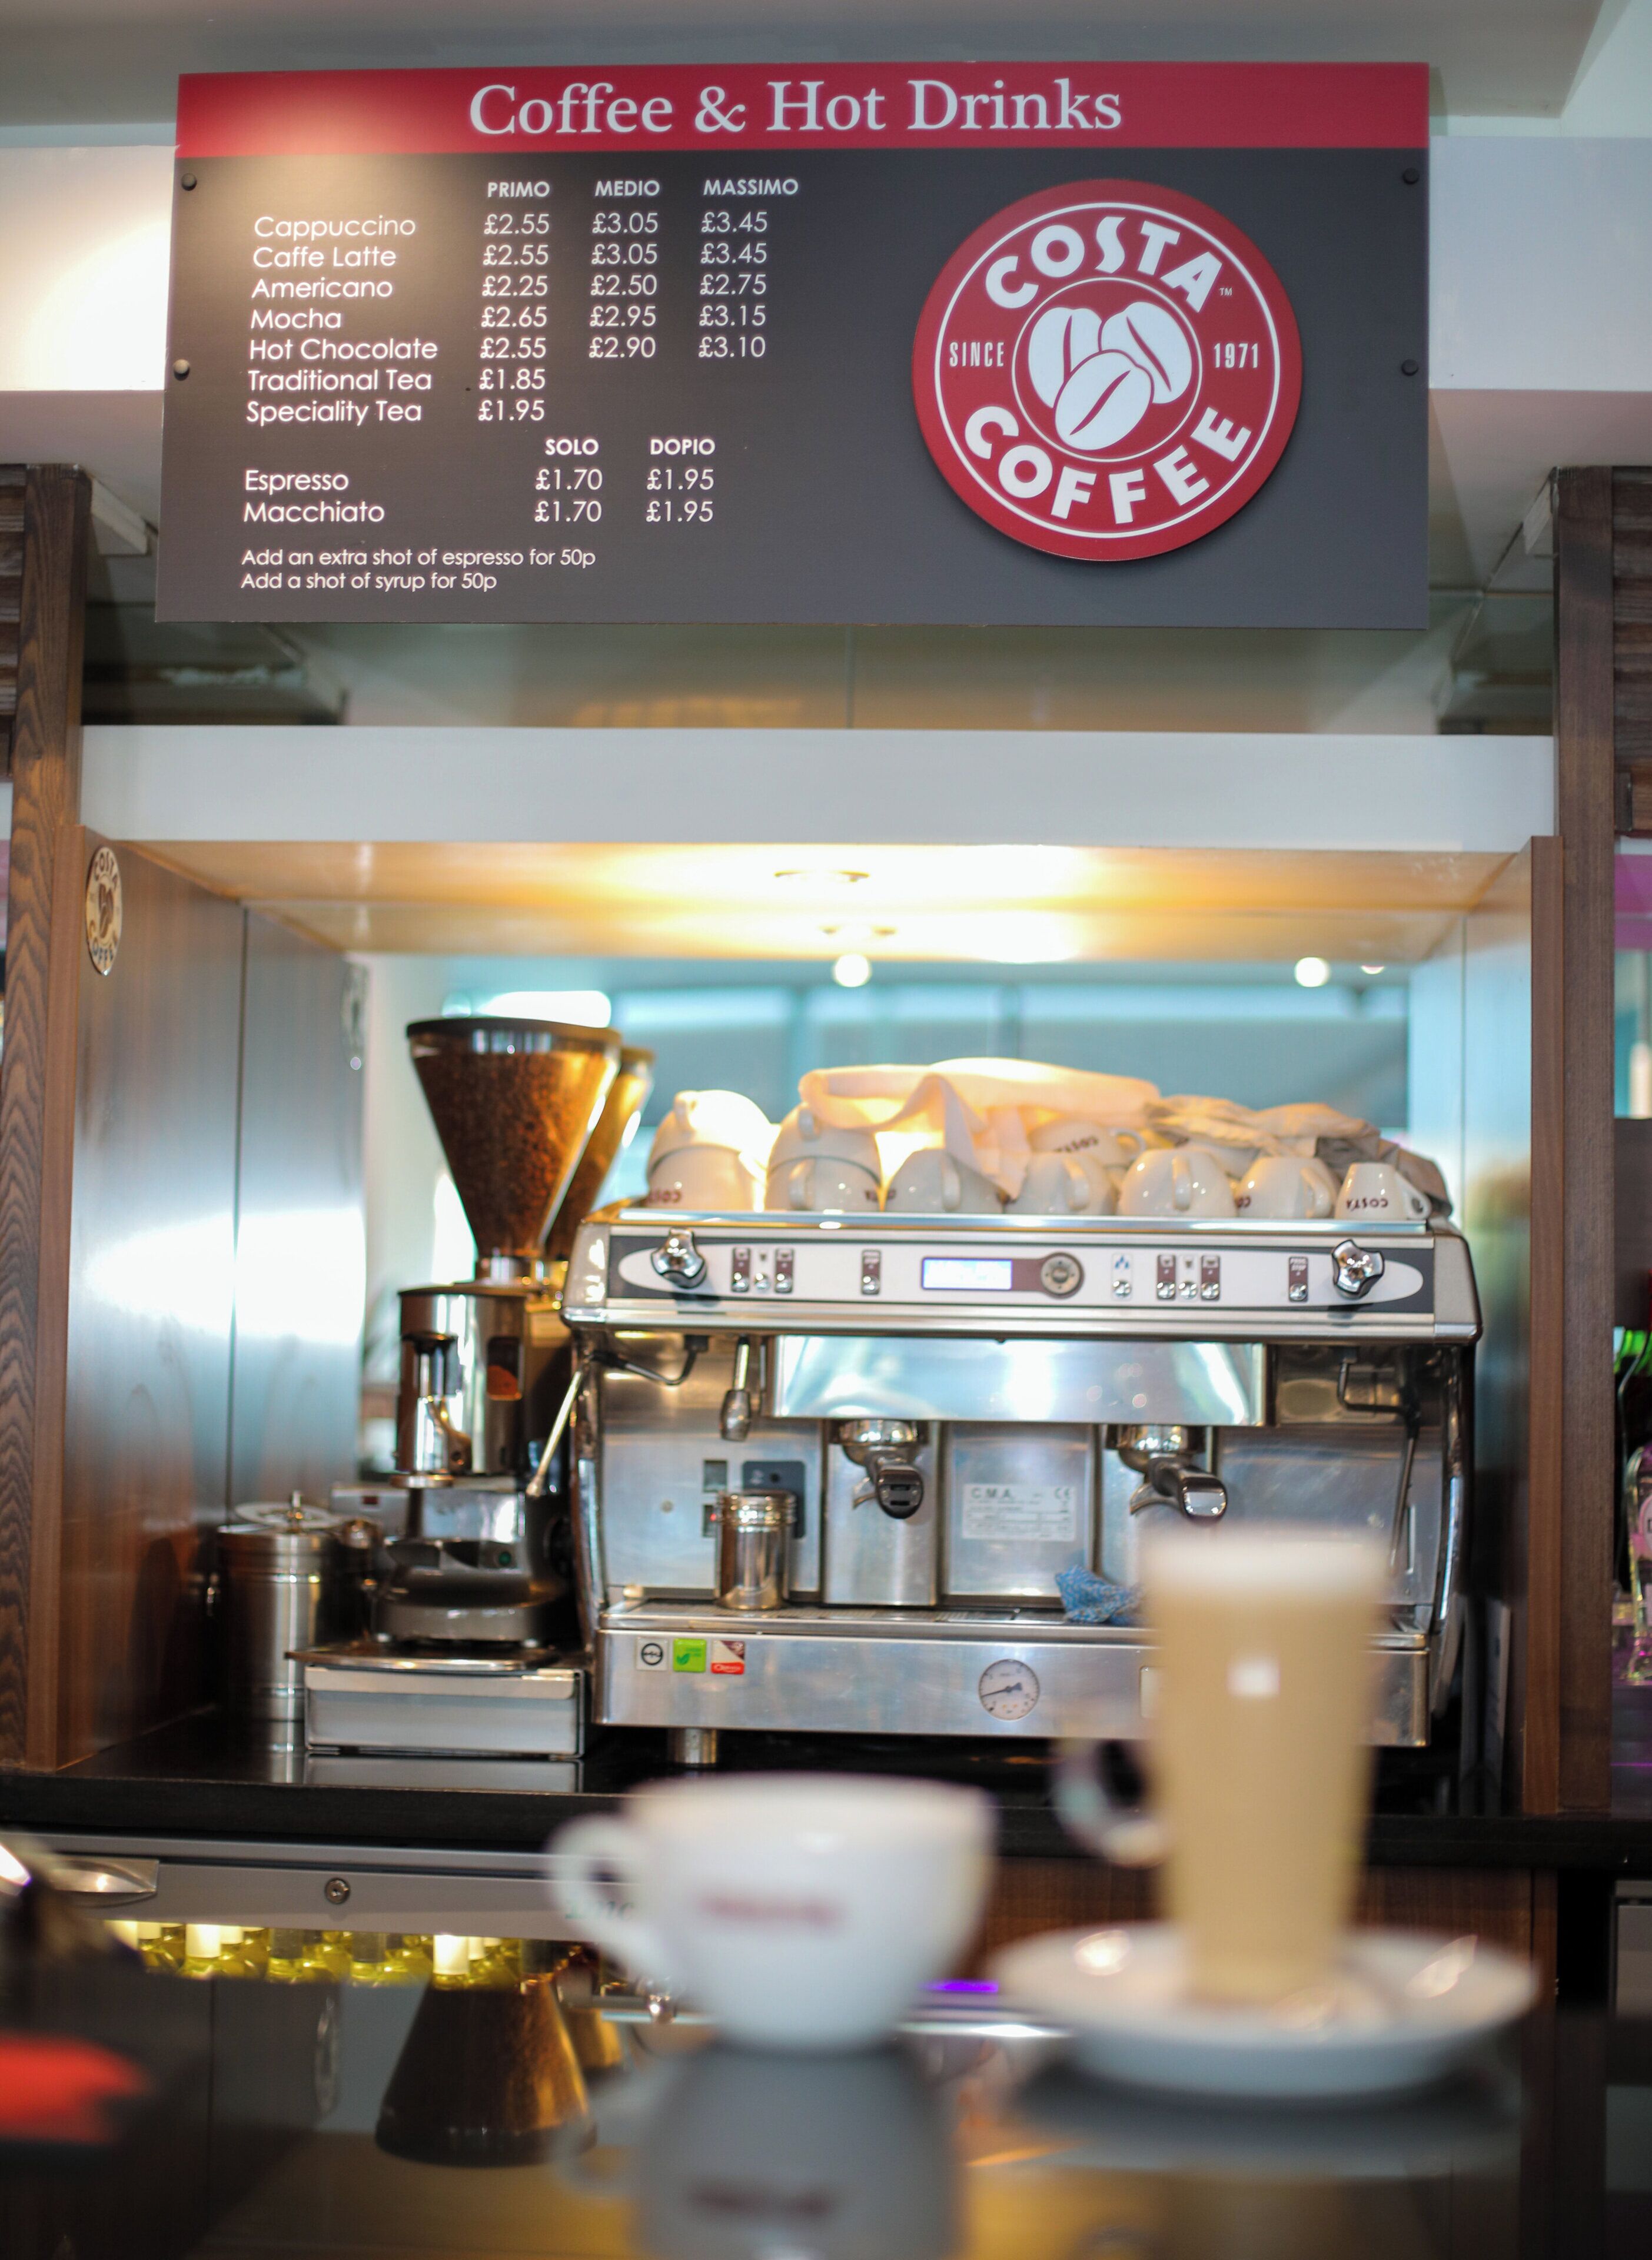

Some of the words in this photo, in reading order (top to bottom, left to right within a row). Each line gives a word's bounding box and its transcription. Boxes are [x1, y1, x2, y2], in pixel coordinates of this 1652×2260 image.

[470, 83, 673, 134] Coffee
[694, 86, 746, 132] &
[766, 81, 886, 131] Hot
[908, 78, 1121, 129] Drinks
[488, 181, 550, 197] PRIMO
[595, 180, 660, 196] MEDIO
[703, 178, 798, 195] MASSIMO
[254, 215, 416, 241] Cappuccino
[484, 214, 549, 234] £2.55
[592, 212, 658, 234] £3.05
[701, 212, 767, 232] £3.45
[253, 247, 324, 268] Caffe
[334, 247, 396, 267] Latte
[483, 245, 549, 265] £2.55
[591, 244, 657, 264] £3.05
[700, 243, 767, 264] £3.45
[985, 216, 1222, 313] COSTA
[251, 277, 393, 298] Americano
[482, 275, 548, 297] £2.25
[590, 274, 657, 295] £2.50
[700, 274, 766, 295] £2.75
[251, 308, 341, 329] Mocha
[481, 306, 547, 327] £2.65
[590, 305, 656, 327] £2.95
[699, 305, 766, 326] £3.15
[250, 340, 293, 360] Hot
[301, 338, 438, 360] Chocolate
[480, 337, 546, 358] £2.55
[589, 337, 656, 358] £2.90
[699, 336, 765, 357] £3.10
[949, 341, 1005, 367] SINCE
[1214, 343, 1259, 368] 1971
[248, 370, 378, 391] Traditional
[386, 370, 431, 390] Tea
[479, 368, 545, 390] £1.85
[246, 400, 369, 427] Speciality
[375, 400, 421, 421] Tea
[478, 400, 544, 421] £1.95
[545, 438, 599, 456] SOLO
[650, 438, 715, 455] DOPIO
[964, 406, 1252, 524] COFFEE
[245, 470, 349, 495] Espresso
[536, 468, 602, 490] £1.70
[647, 468, 713, 490] £1.95
[244, 501, 385, 522] Macchiato
[534, 501, 601, 522] £1.70
[646, 501, 713, 522] £1.95
[241, 549, 282, 565] Add
[288, 553, 313, 565] an
[319, 549, 367, 565] extra
[373, 549, 413, 565] shot
[418, 549, 437, 565] of
[443, 553, 523, 569] espresso
[530, 549, 556, 565] for
[560, 549, 596, 569] 50p
[241, 573, 282, 589] Add
[288, 576, 301, 589] a
[306, 573, 346, 589] shot
[351, 572, 371, 589] of
[375, 576, 425, 592] syrup
[431, 572, 457, 589] for
[461, 573, 497, 592] 50p
[1347, 1198, 1389, 1211] COSTA
